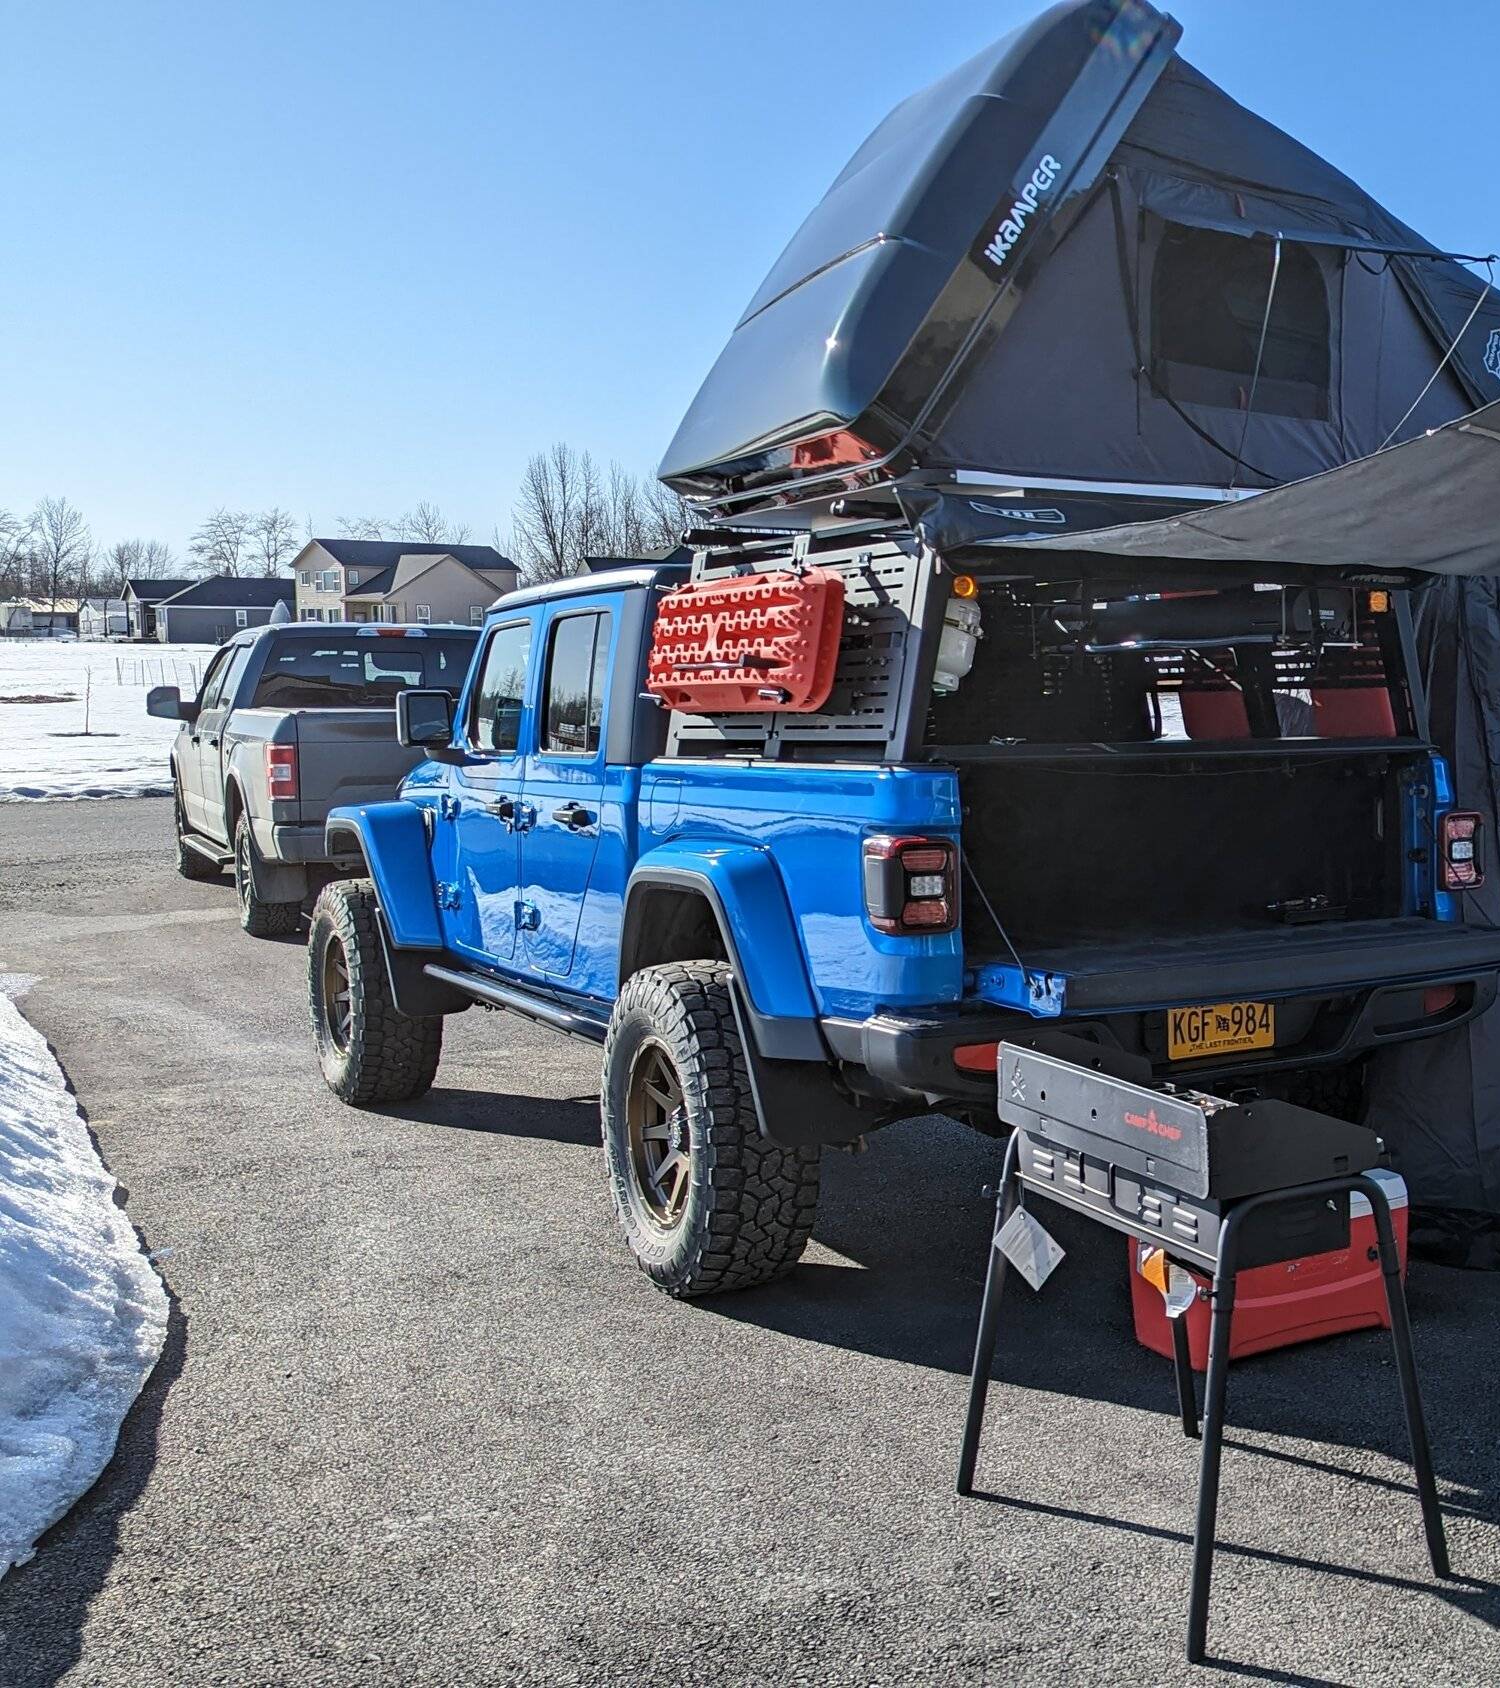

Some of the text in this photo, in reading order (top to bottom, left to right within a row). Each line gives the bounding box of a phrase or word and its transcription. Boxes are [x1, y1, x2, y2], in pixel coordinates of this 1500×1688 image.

[1173, 1003, 1271, 1045] KGF 984
[1206, 1040, 1221, 1048] LAST
[1223, 1036, 1251, 1046] FRONTIER
